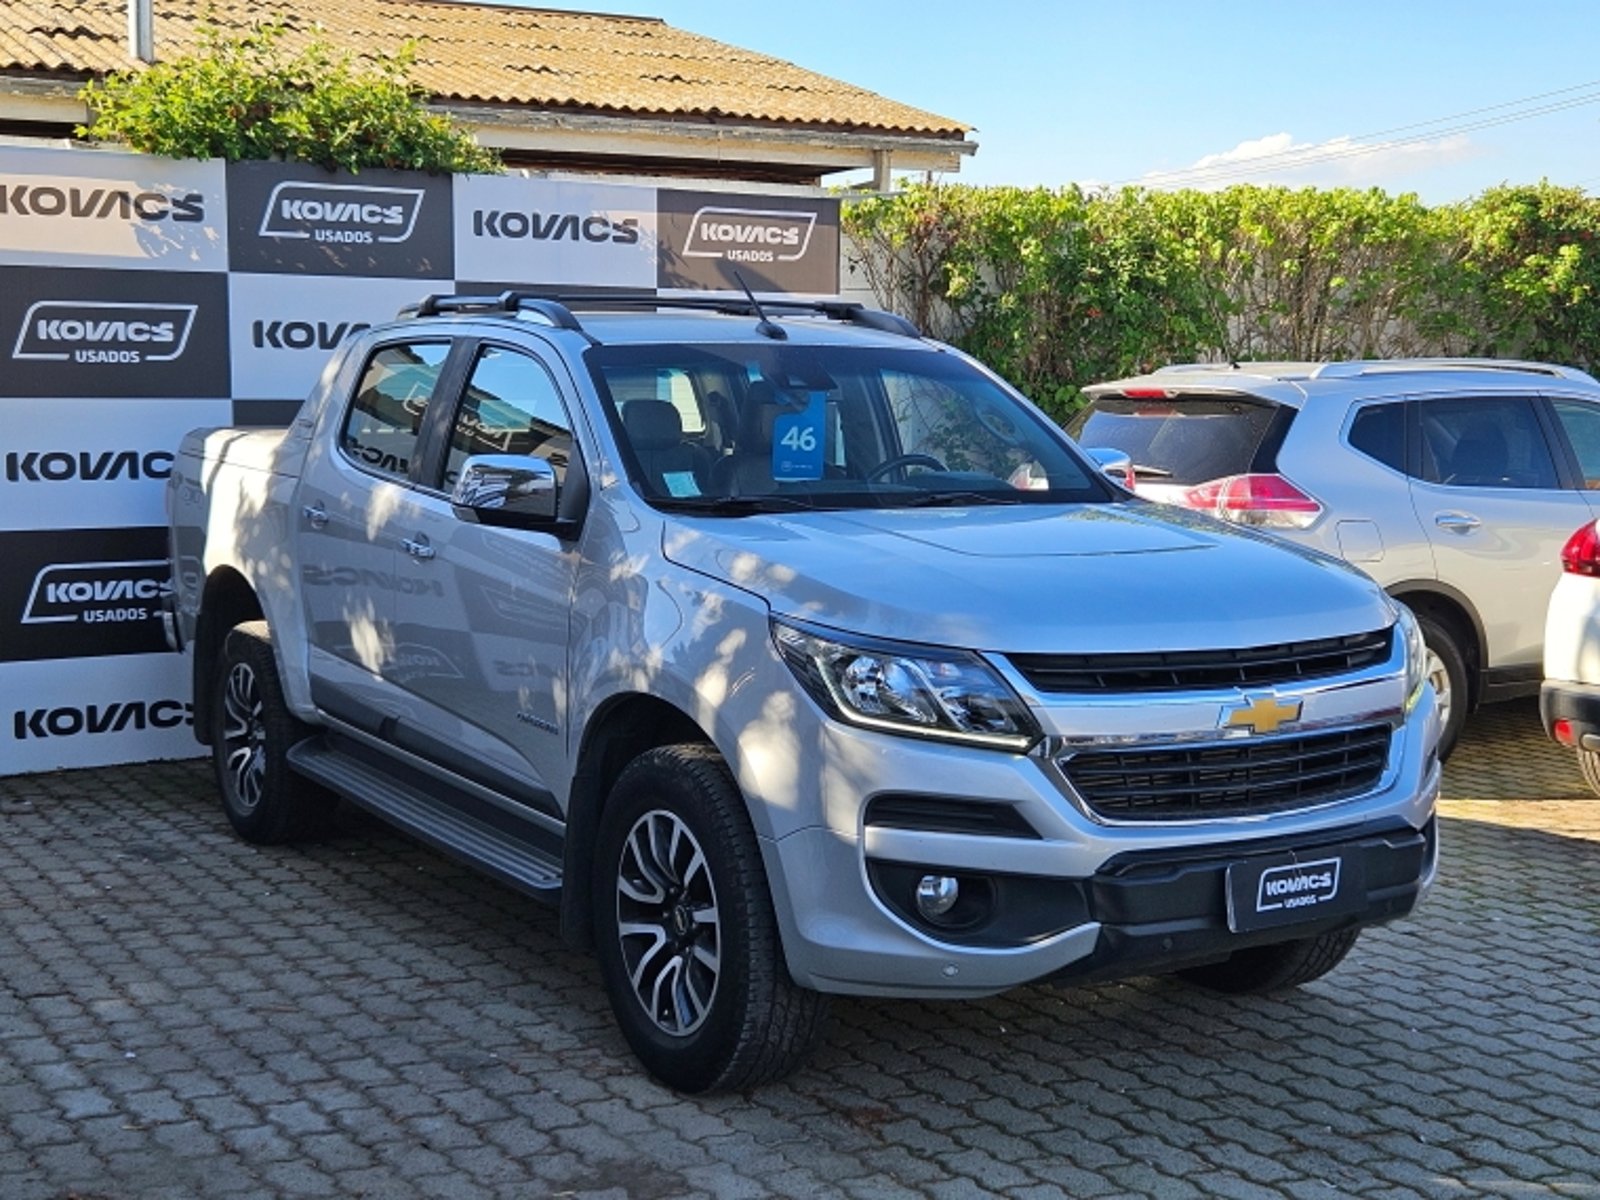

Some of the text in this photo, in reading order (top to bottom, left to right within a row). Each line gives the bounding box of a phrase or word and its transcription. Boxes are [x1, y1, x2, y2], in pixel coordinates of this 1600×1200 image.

[0, 185, 204, 222] KOVACS
[281, 200, 403, 223] KOVACS
[315, 229, 373, 244] USADOS
[473, 210, 638, 244] KOVACS
[700, 223, 798, 245] KOVACS
[727, 250, 774, 262] USADOS
[37, 319, 174, 342] KOVACS
[253, 319, 371, 350] KOV
[75, 350, 140, 363] USADOS
[780, 426, 816, 451] 46
[6, 451, 174, 482] KOVAC
[83, 608, 148, 623] USADOS
[1266, 872, 1332, 896] KOVACS
